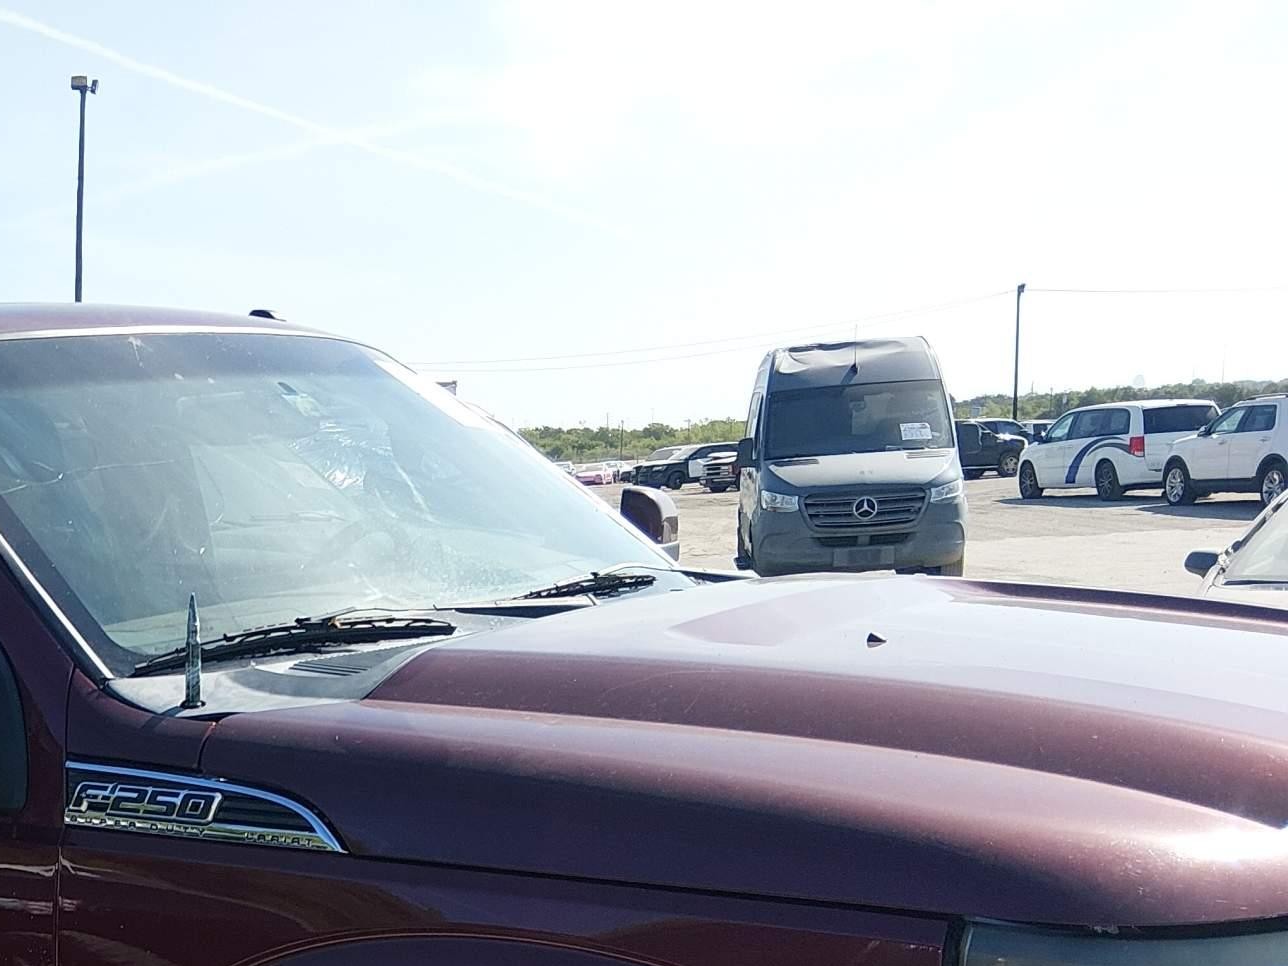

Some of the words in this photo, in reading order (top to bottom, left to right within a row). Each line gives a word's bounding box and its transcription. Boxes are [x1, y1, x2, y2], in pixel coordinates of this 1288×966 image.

[70, 815, 137, 831] SUPER
[150, 822, 207, 838] DUTY
[244, 832, 314, 848] LARIAT
